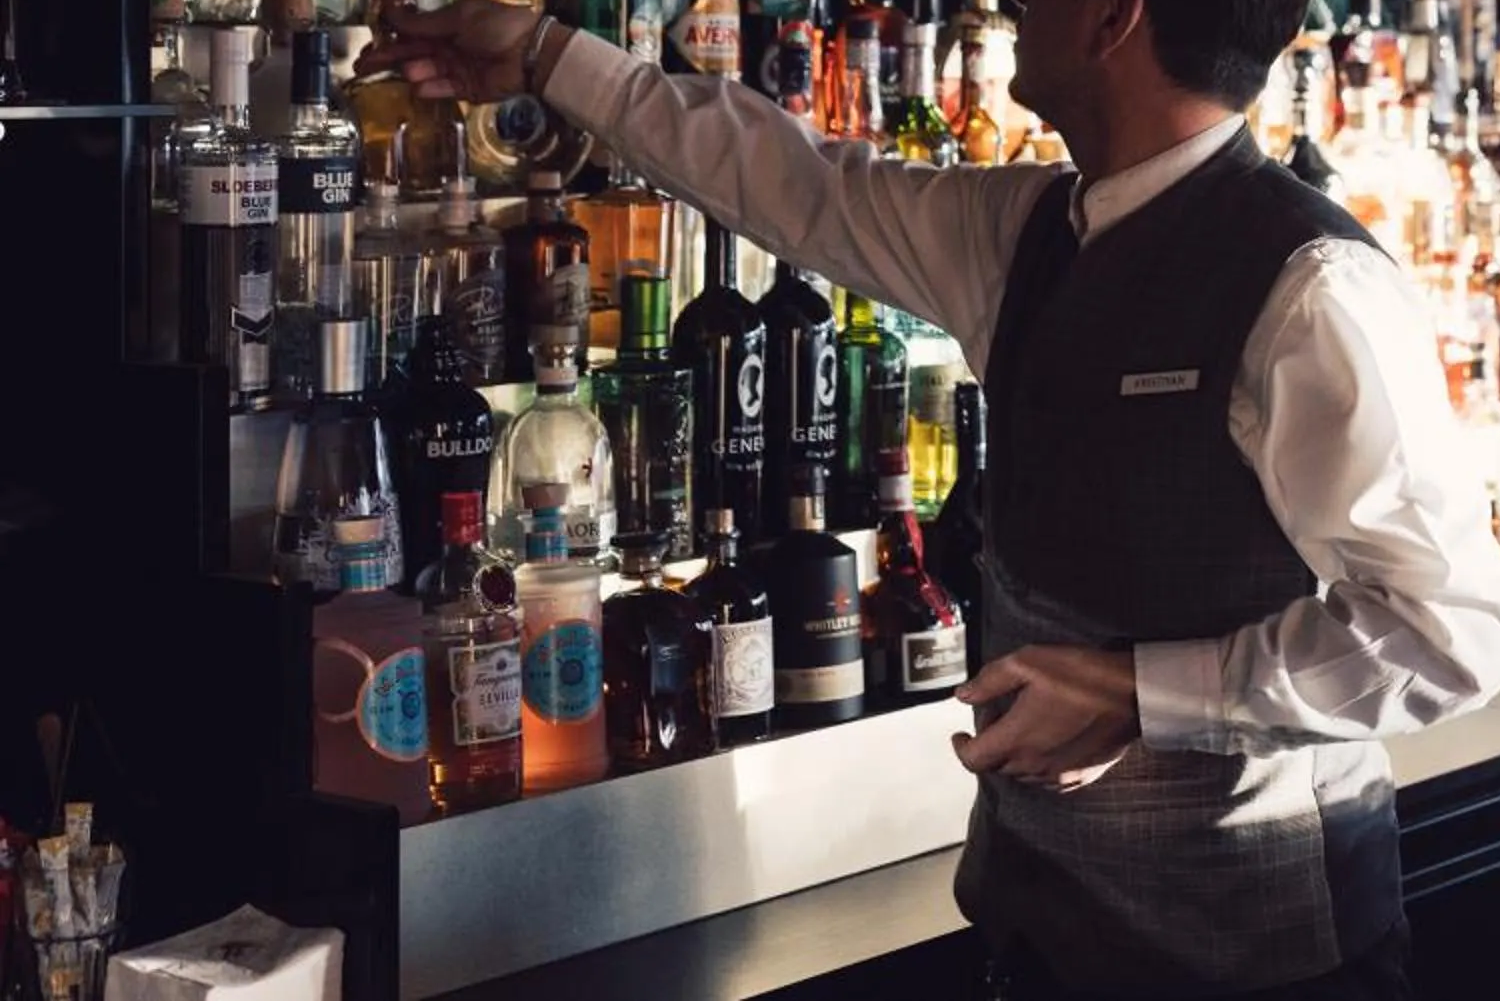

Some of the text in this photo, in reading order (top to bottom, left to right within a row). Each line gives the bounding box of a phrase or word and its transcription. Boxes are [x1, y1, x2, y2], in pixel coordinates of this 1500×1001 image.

[313, 171, 354, 189] BLUE
[241, 196, 272, 209] BLUE
[322, 187, 351, 204] GIN
[247, 208, 270, 220] GIN
[791, 424, 838, 443] GENE
[426, 436, 493, 458] BULLDO
